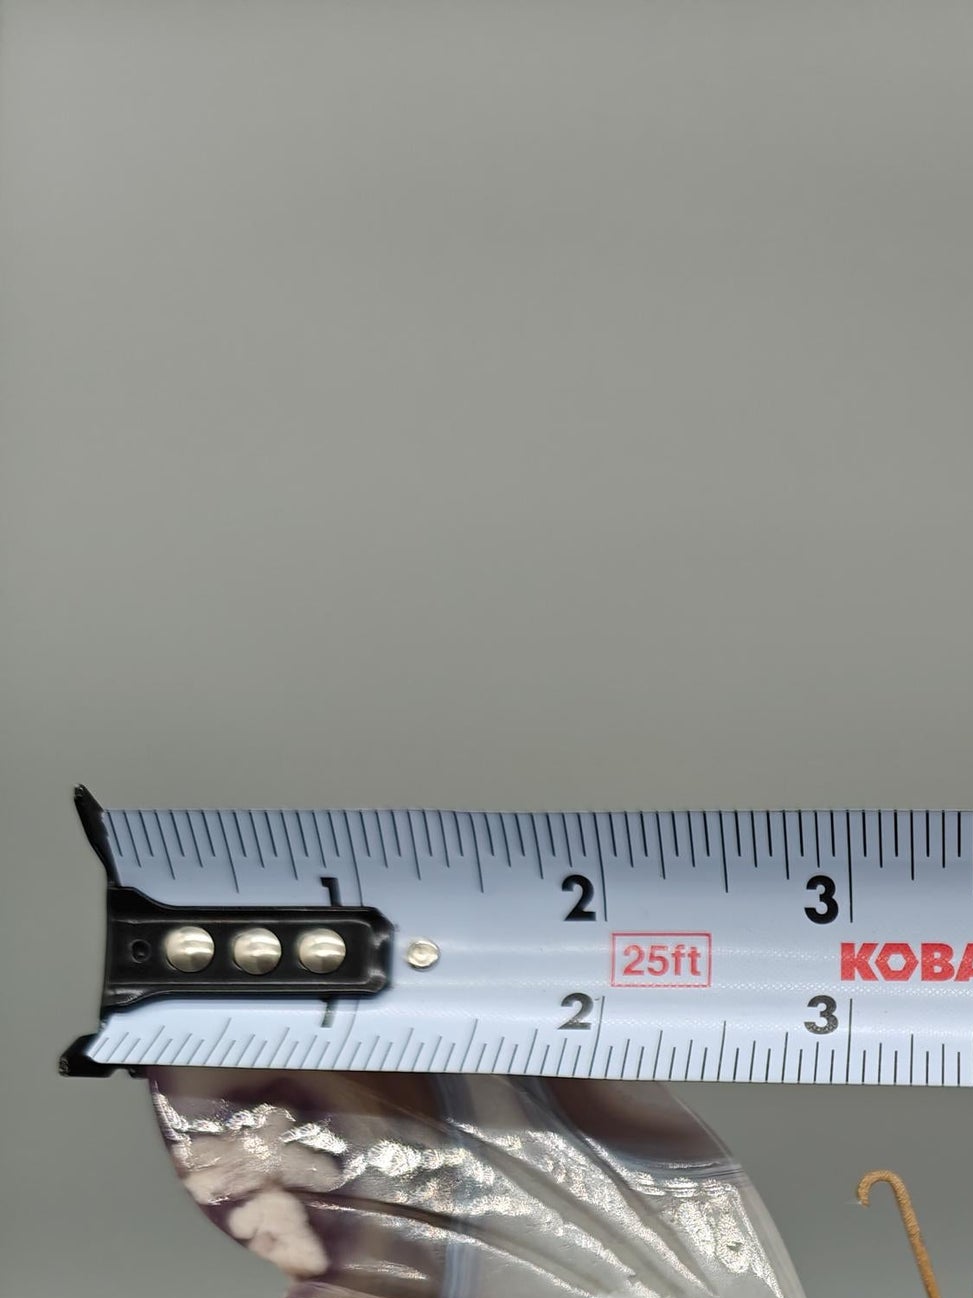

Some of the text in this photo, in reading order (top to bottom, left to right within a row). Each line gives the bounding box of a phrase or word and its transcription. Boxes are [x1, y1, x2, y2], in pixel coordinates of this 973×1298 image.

[320, 877, 341, 906] 1
[561, 875, 597, 921] 2
[804, 875, 839, 924] 3
[622, 944, 702, 977] 25ft
[320, 997, 339, 1028] 1
[557, 993, 593, 1030] 2
[804, 995, 839, 1034] 3
